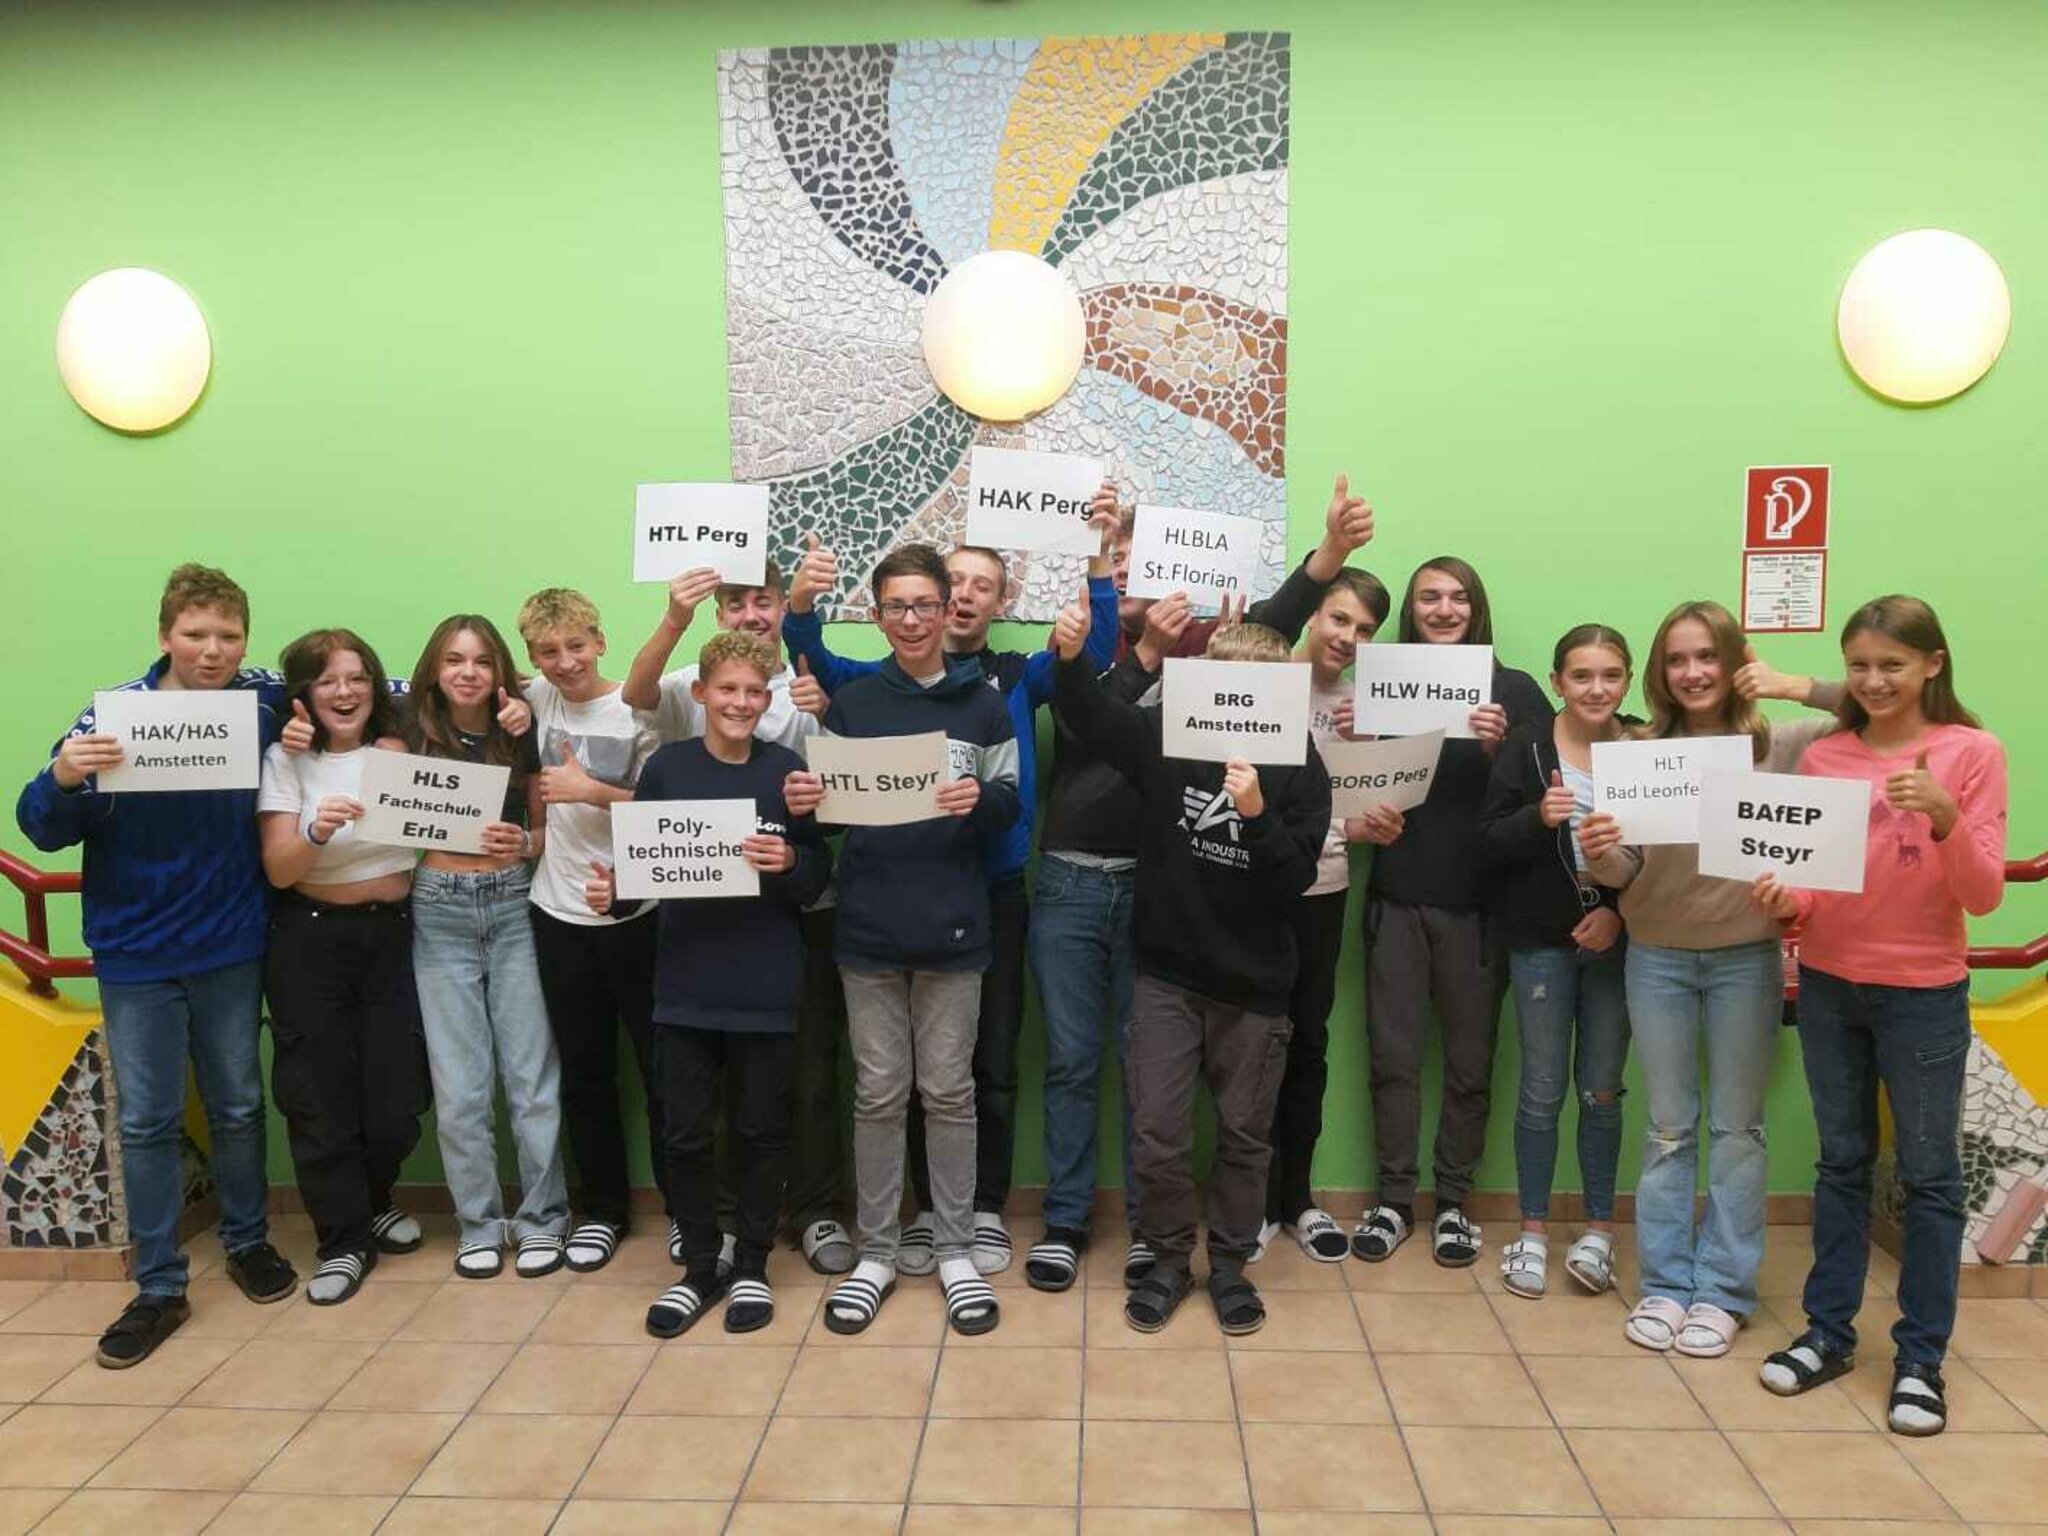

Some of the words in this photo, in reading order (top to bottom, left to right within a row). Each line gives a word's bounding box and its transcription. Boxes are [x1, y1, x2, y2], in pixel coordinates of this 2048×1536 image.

[978, 487, 1033, 512] HAK
[1040, 491, 1094, 522] Perg
[648, 525, 690, 543] HTL
[696, 526, 749, 549] Perg
[1164, 526, 1229, 552] HLBLA
[1143, 560, 1239, 590] St.Florian
[1214, 692, 1255, 708] BRG
[1370, 681, 1420, 701] HLW
[1426, 683, 1481, 706] Haag
[131, 722, 229, 743] HAK/HAS
[1185, 715, 1282, 735] Amstetten
[133, 752, 227, 768] Amstetten
[1655, 756, 1686, 771] HLT
[412, 769, 461, 791] HLS
[822, 772, 869, 792] HTL
[876, 771, 940, 792] Steyr
[1330, 772, 1388, 790] BORG
[1392, 766, 1430, 786] Perg
[1606, 785, 1638, 800] Bad
[1643, 782, 1699, 799] Leonfe
[378, 792, 482, 818] Fachschule
[1737, 800, 1823, 827] BAfEP
[402, 821, 448, 842] Erla
[657, 816, 713, 838] Poly-
[627, 840, 742, 860] technische
[1201, 839, 1250, 863] INDUSTR
[1740, 836, 1815, 866] Steyr
[651, 865, 724, 884] Schule
